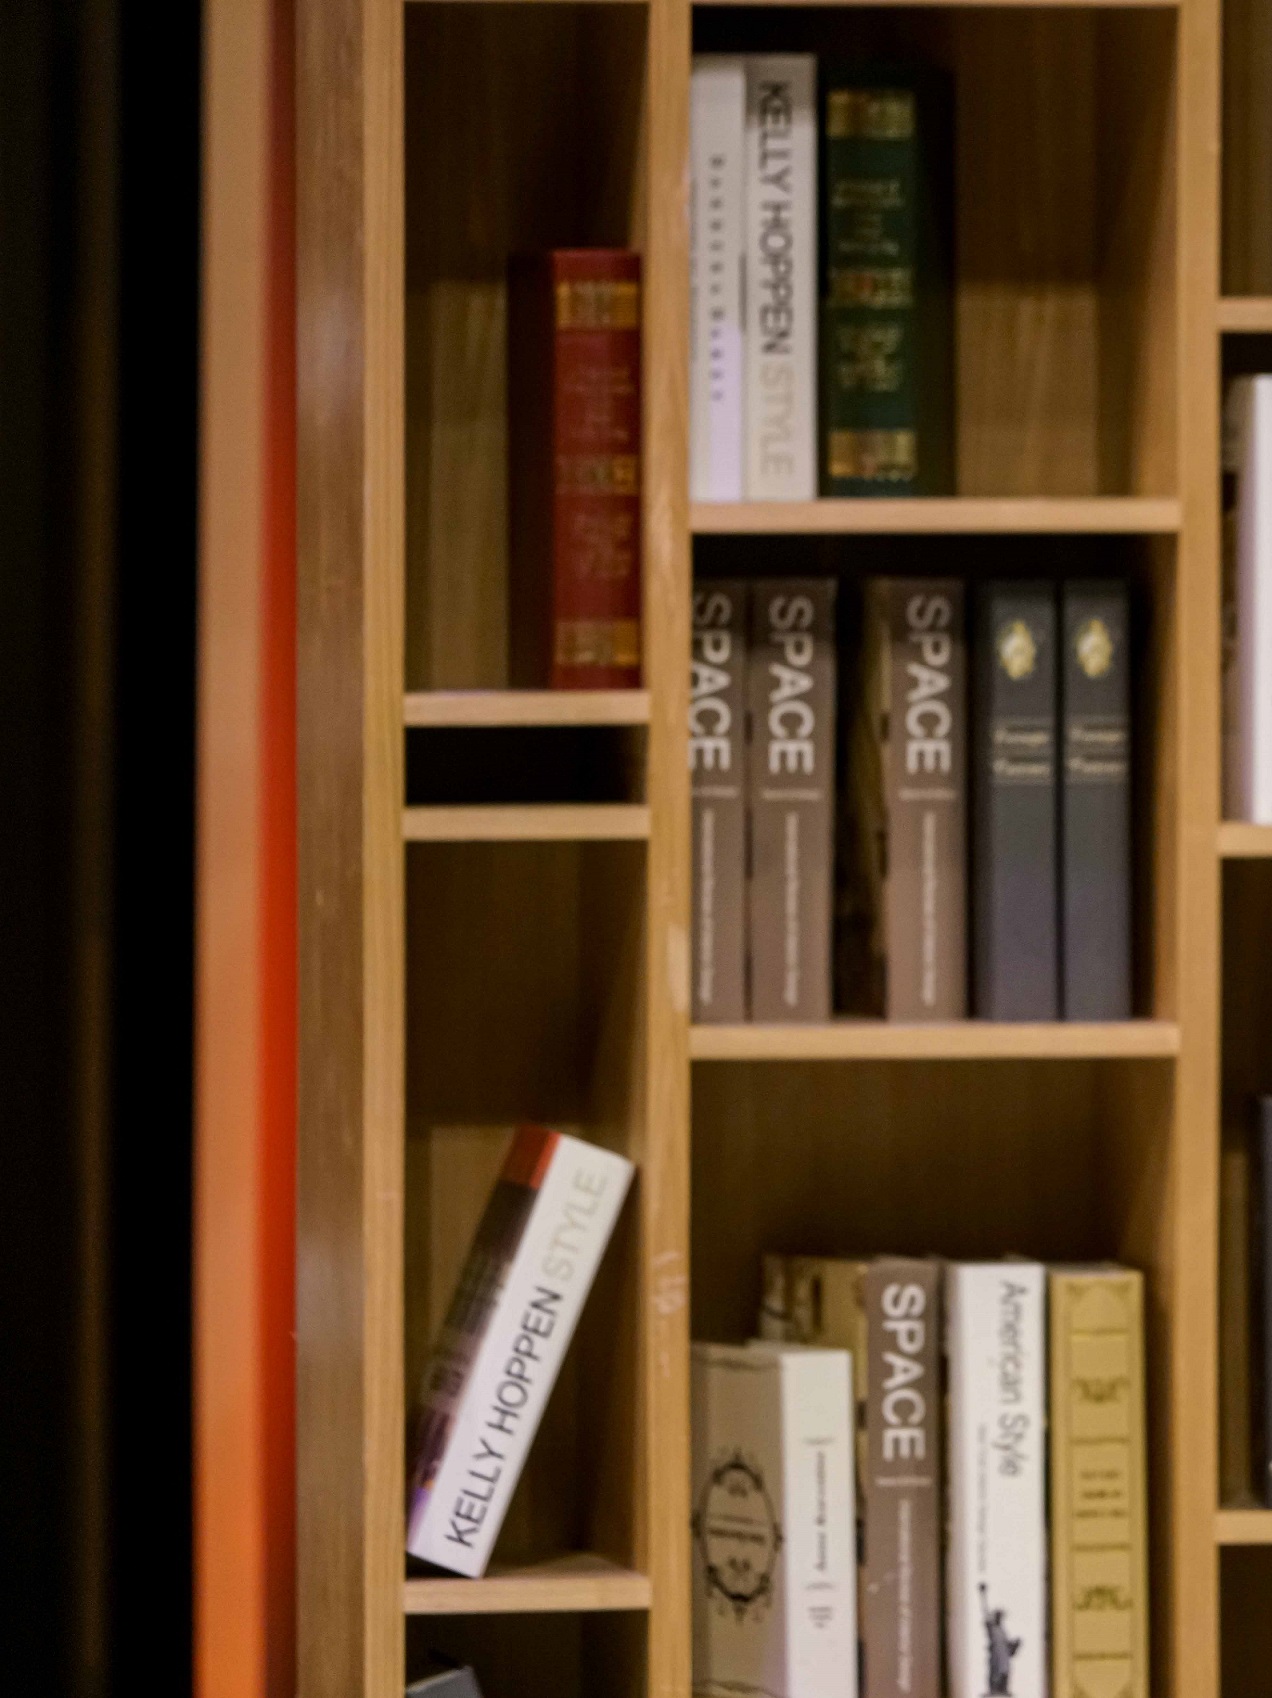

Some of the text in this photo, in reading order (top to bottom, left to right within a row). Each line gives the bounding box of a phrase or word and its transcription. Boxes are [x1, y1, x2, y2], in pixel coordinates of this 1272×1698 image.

[757, 81, 795, 477] KELLY HOPPEN STYLE
[690, 593, 732, 771] SPACE
[767, 595, 815, 775] SPACE
[905, 595, 952, 775] SPACE
[445, 1169, 607, 1549] KELLY HOPPEN STYLE
[881, 1283, 926, 1462] SPACE
[992, 1281, 1030, 1477] American Style
